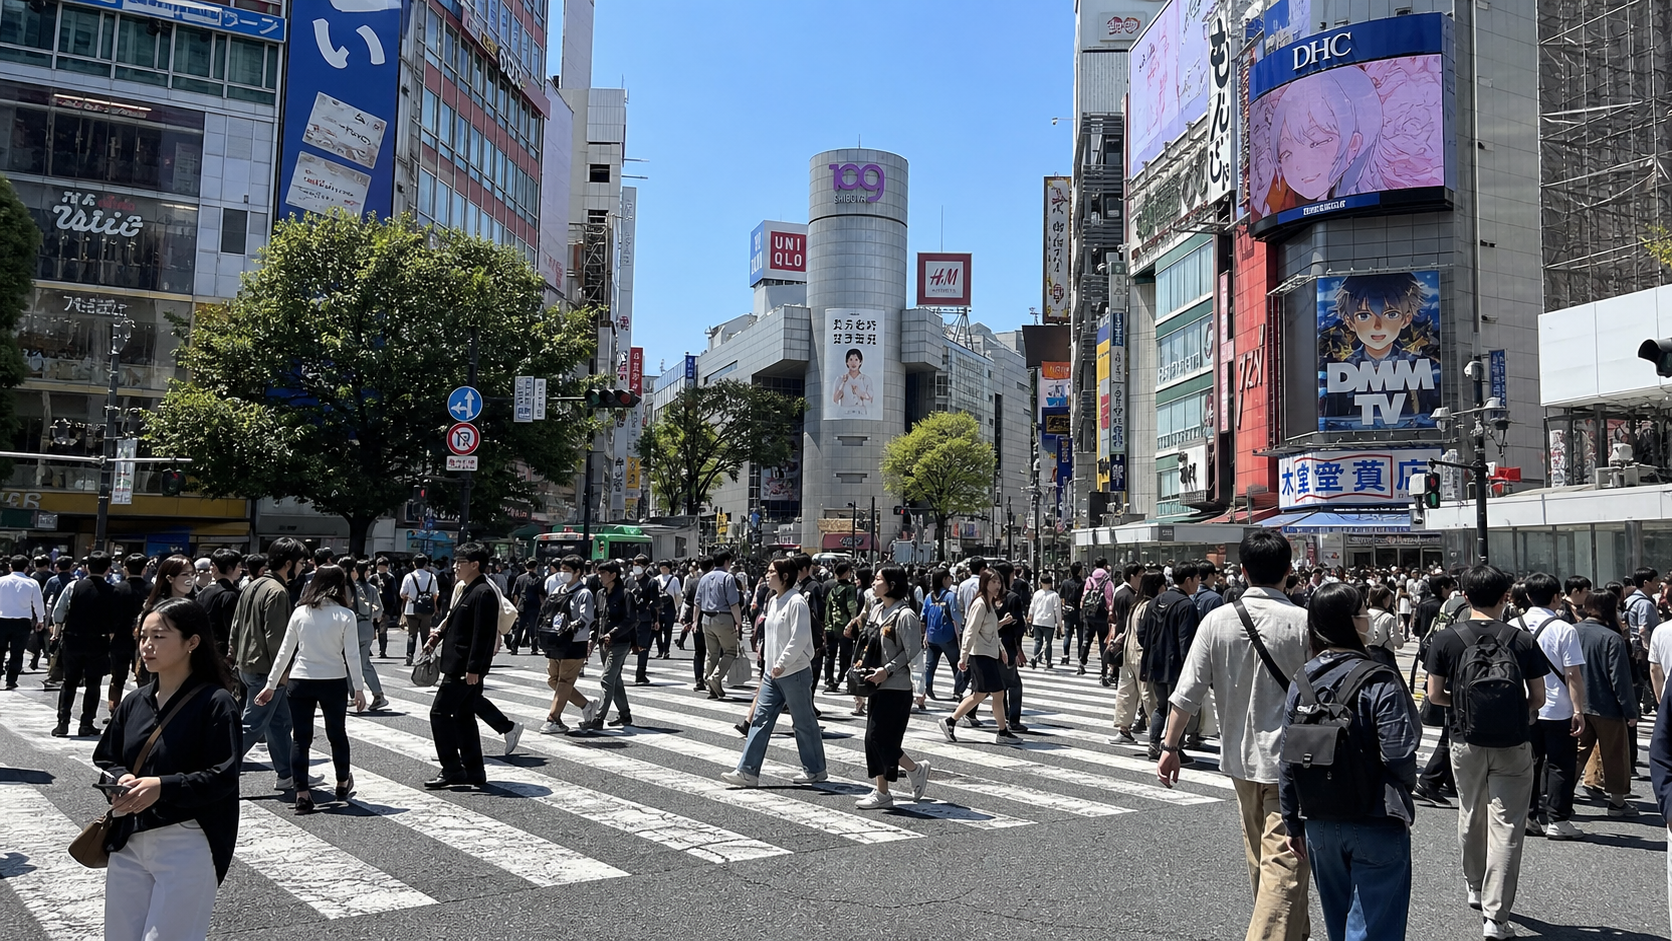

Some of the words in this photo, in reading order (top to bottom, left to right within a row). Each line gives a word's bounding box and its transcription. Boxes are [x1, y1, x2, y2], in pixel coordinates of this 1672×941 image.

[1292, 31, 1352, 71] DHC
[828, 163, 885, 203] 109
[774, 235, 800, 251] UNI
[774, 251, 802, 267] QLO
[1327, 358, 1435, 393] DMM
[1354, 392, 1407, 426] TV
